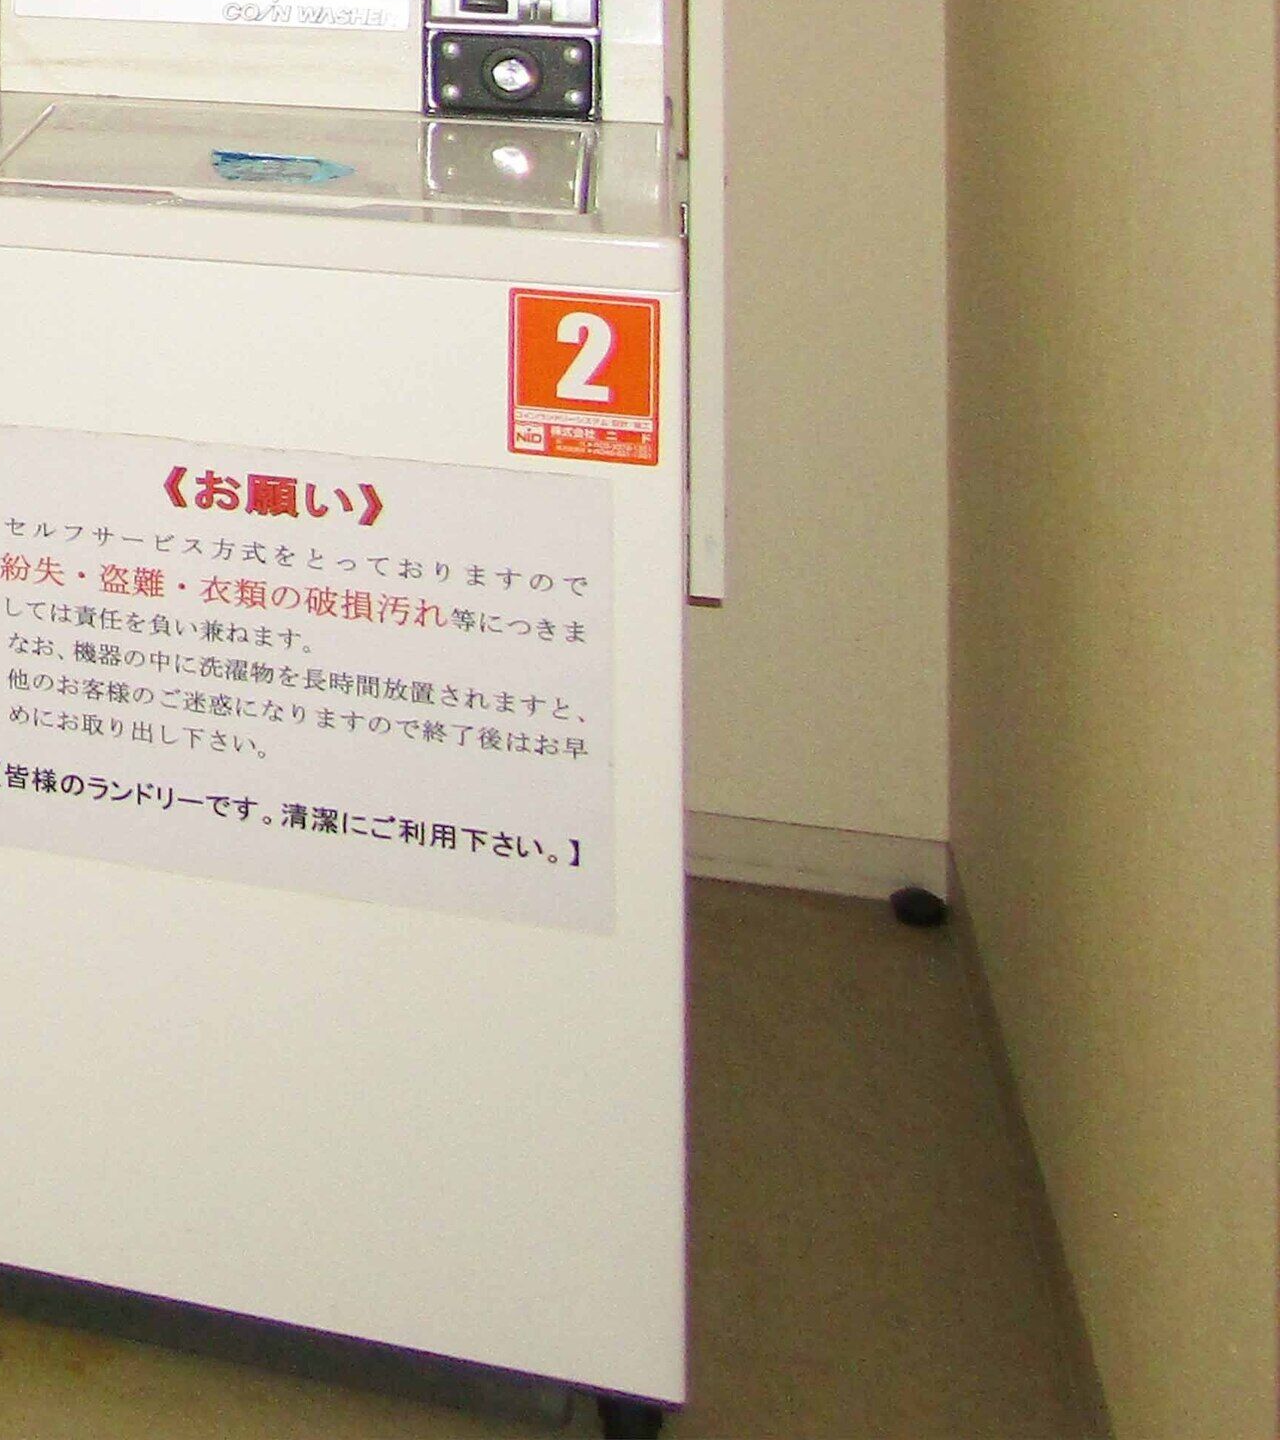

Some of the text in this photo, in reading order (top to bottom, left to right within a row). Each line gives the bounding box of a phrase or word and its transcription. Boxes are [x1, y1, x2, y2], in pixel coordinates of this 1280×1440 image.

[555, 311, 612, 402] 2
[0, 551, 588, 646] 紛失・盗難・衣類の破損汚れ等につきま
[4, 596, 314, 656] しては責任を負い兼ねます。
[7, 667, 589, 762] 他のお客様のご迷惑になりますので終了後はお早
[8, 631, 588, 725] なお、機器の中に洗濯物を長時間放置されますと、
[9, 704, 269, 760] めにお取り出し下さい。
